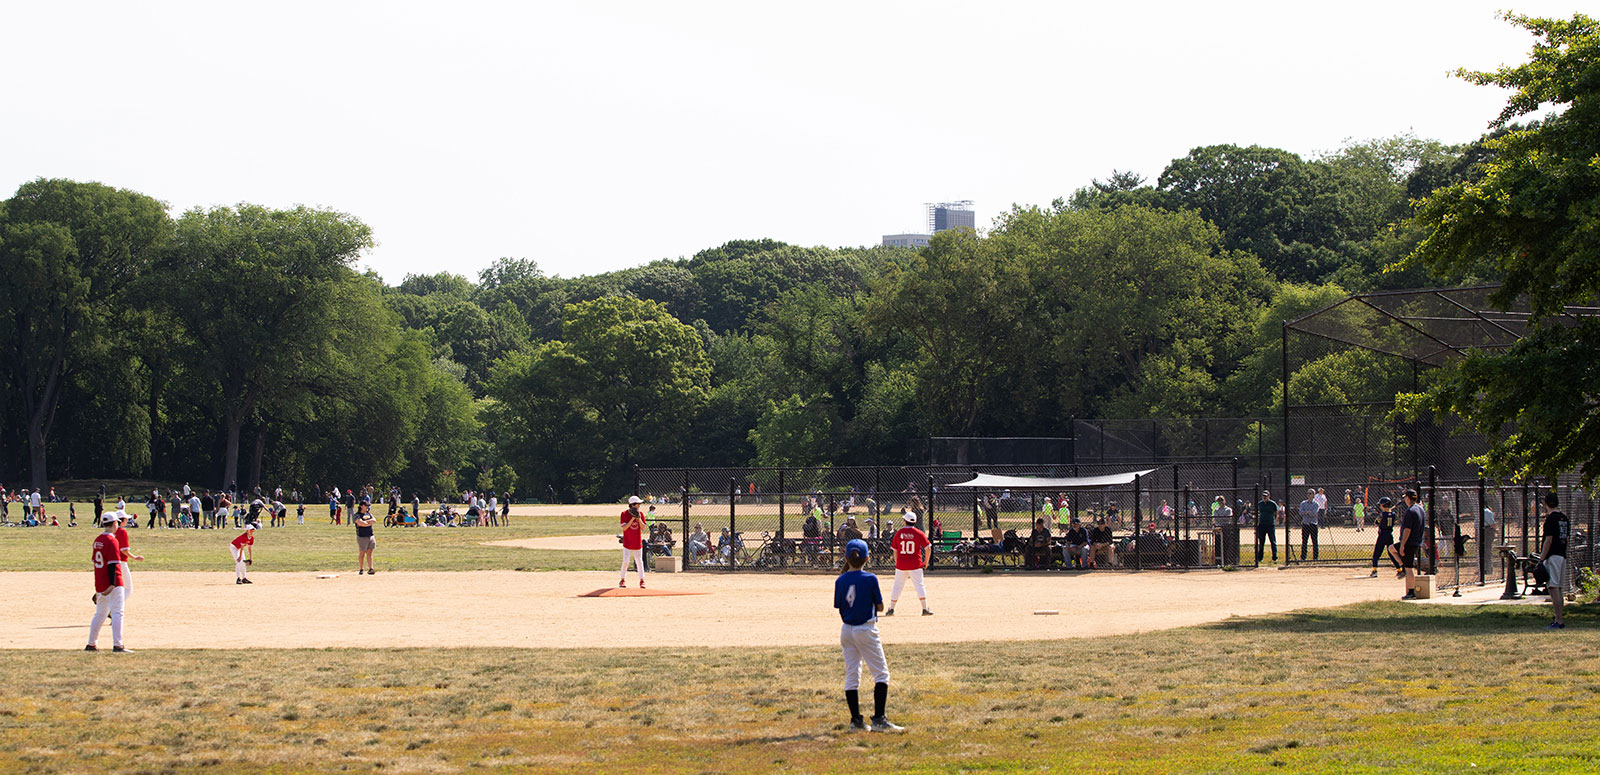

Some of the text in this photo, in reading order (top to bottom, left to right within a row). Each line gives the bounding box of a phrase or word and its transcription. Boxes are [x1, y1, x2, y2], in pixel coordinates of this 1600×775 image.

[900, 541, 915, 554] 10
[95, 551, 104, 568] 9
[846, 584, 856, 607] 4
